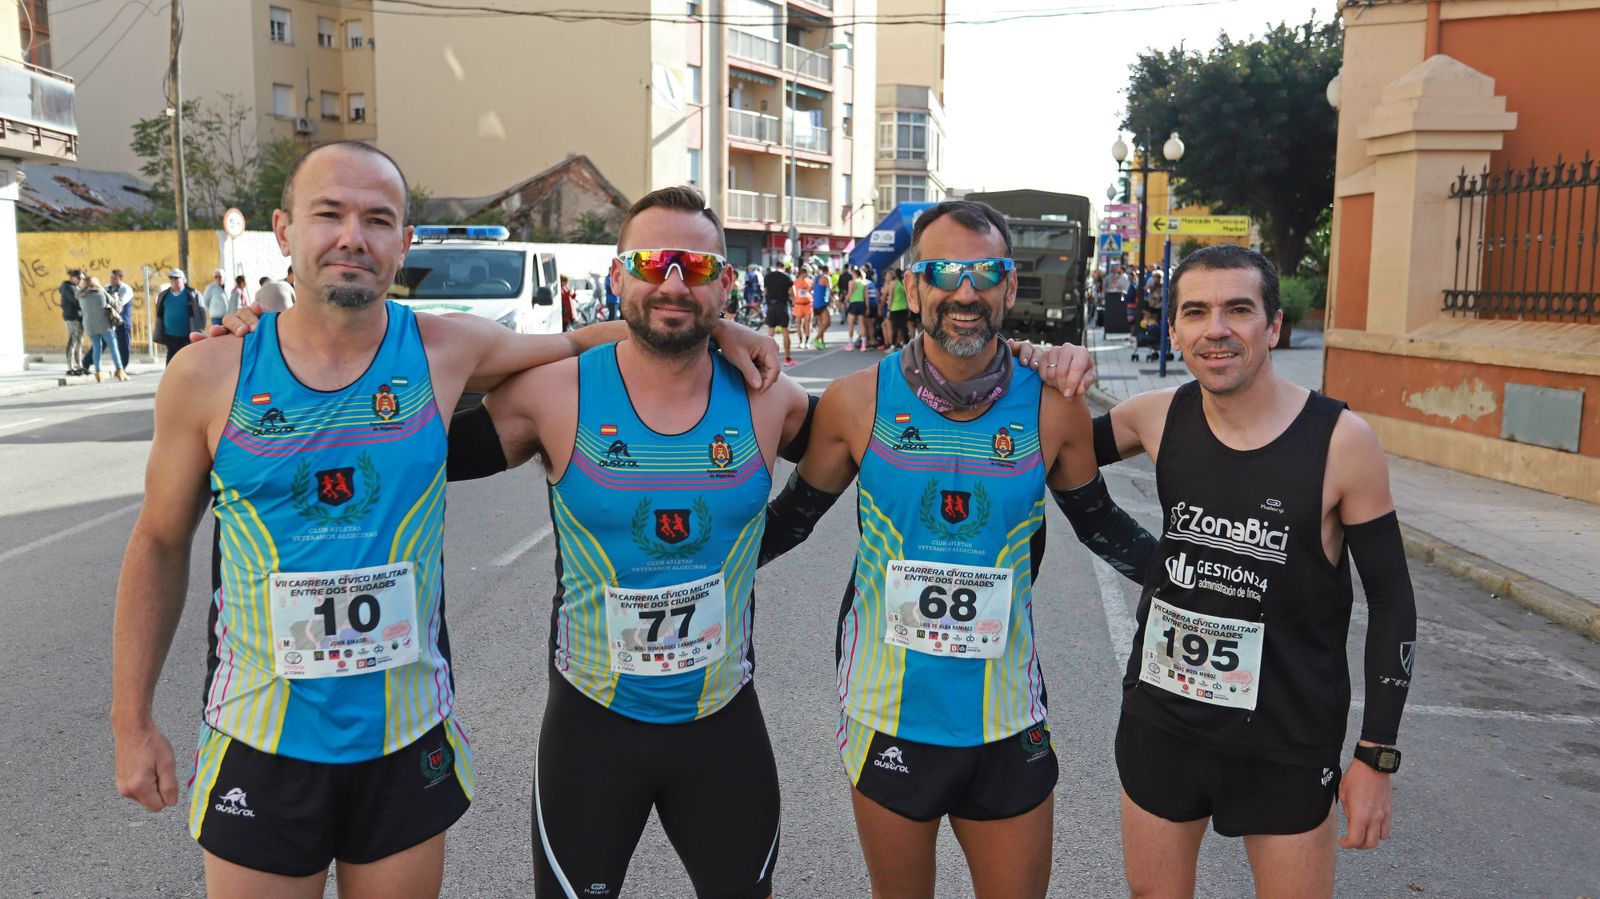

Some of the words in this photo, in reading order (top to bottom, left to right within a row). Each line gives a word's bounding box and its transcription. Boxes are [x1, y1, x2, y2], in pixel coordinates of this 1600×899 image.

[329, 525, 362, 533] ATLETAS
[1188, 505, 1290, 551] ZonaBici
[917, 544, 951, 553] VETERANOS
[952, 547, 986, 555] ALGECIRAS
[275, 580, 287, 588] VII
[288, 578, 336, 588] CARRERA
[338, 574, 370, 585] CÍVICO
[372, 568, 408, 580] MILITAR
[891, 564, 903, 572] VII
[904, 565, 945, 576] CARRERA
[946, 568, 974, 578] CÍVICO
[975, 573, 1007, 581] MILITAR
[904, 574, 934, 583] ENTRE
[935, 576, 953, 585] DOS
[954, 578, 995, 588] CIUDADES
[291, 587, 324, 597] ENTRE
[326, 586, 347, 595] DOS
[349, 579, 396, 593] CIUDADES
[618, 594, 659, 602] CARRERA
[661, 590, 689, 600] CÍVICO
[690, 579, 720, 594] MILITAR
[1237, 587, 1246, 598] de
[651, 600, 670, 608] DOS
[671, 590, 710, 606] CIUDADES
[918, 585, 977, 622] 68
[314, 594, 381, 636] 10
[638, 603, 696, 643] 77
[1154, 603, 1162, 611] VII
[1162, 607, 1191, 623] CARRERA
[1192, 617, 1220, 629] CÍVICO
[1220, 623, 1258, 633] MILITAR
[1162, 614, 1183, 627] ENTRE
[1182, 623, 1199, 633] DOS
[1199, 627, 1244, 640] CIUDADES
[1163, 626, 1240, 672] 195
